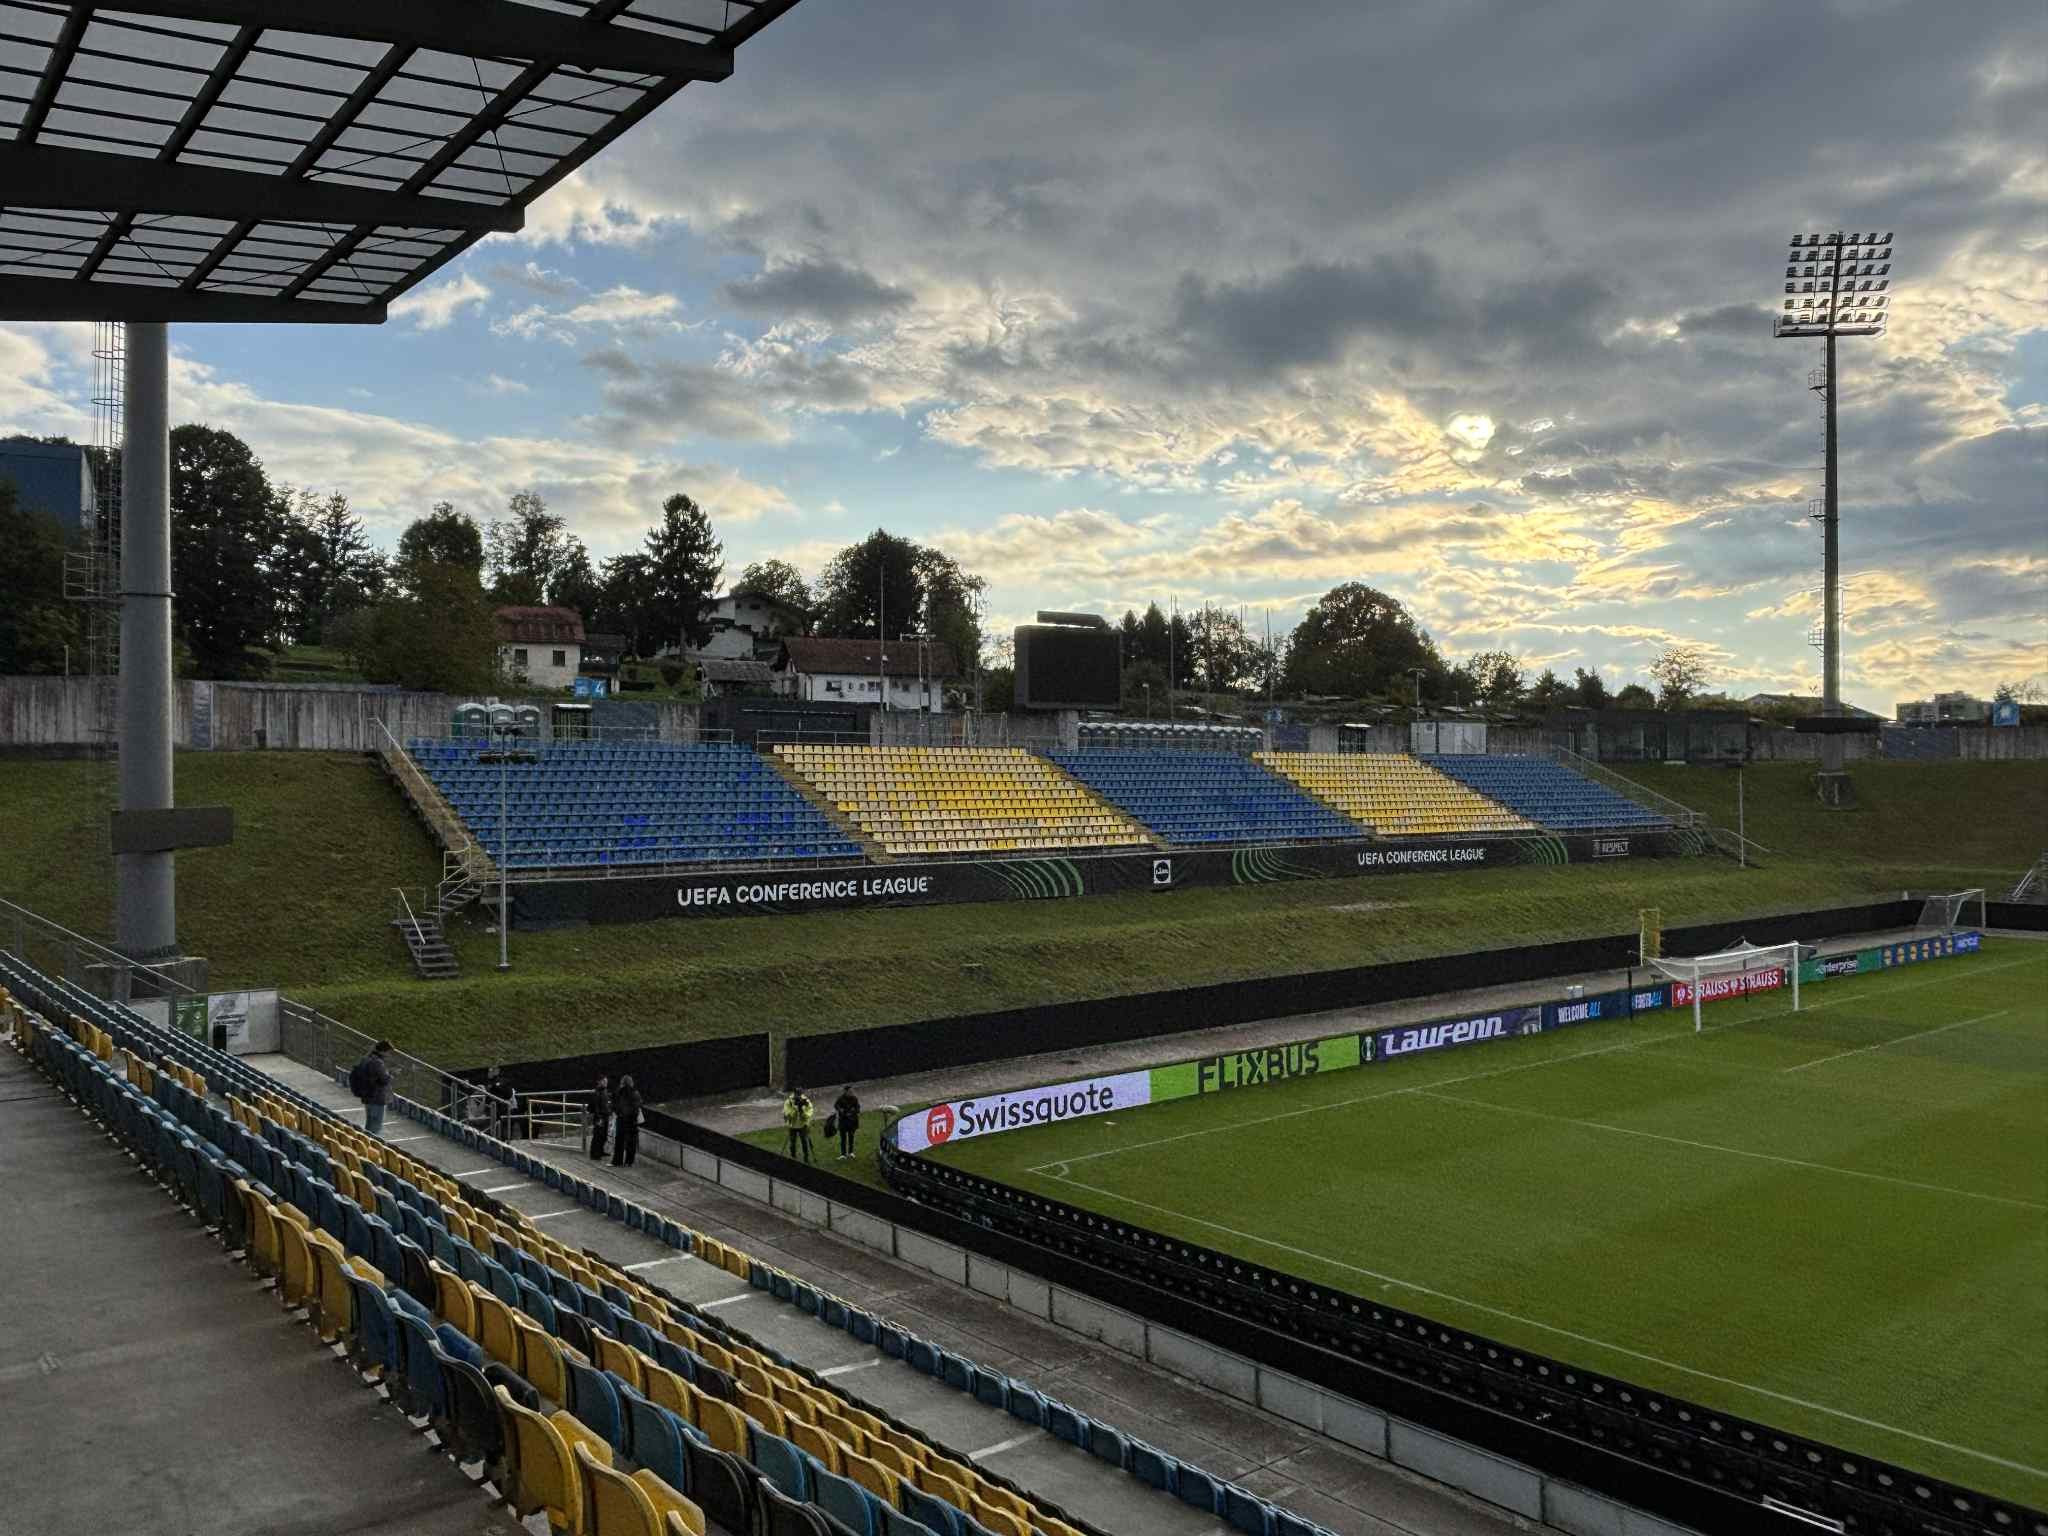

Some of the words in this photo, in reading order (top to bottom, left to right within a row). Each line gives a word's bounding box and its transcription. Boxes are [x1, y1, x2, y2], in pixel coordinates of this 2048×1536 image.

[1357, 851, 1384, 866] UEFA
[1386, 849, 1447, 864] CONFERENCE
[1450, 848, 1485, 861] LEAGUE
[677, 886, 731, 906] UEFA
[735, 880, 857, 903] CONFERENCE
[863, 876, 928, 896] LEAGUE
[1687, 980, 1729, 1001] SRAUSS
[958, 1083, 1114, 1136] Swissquote
